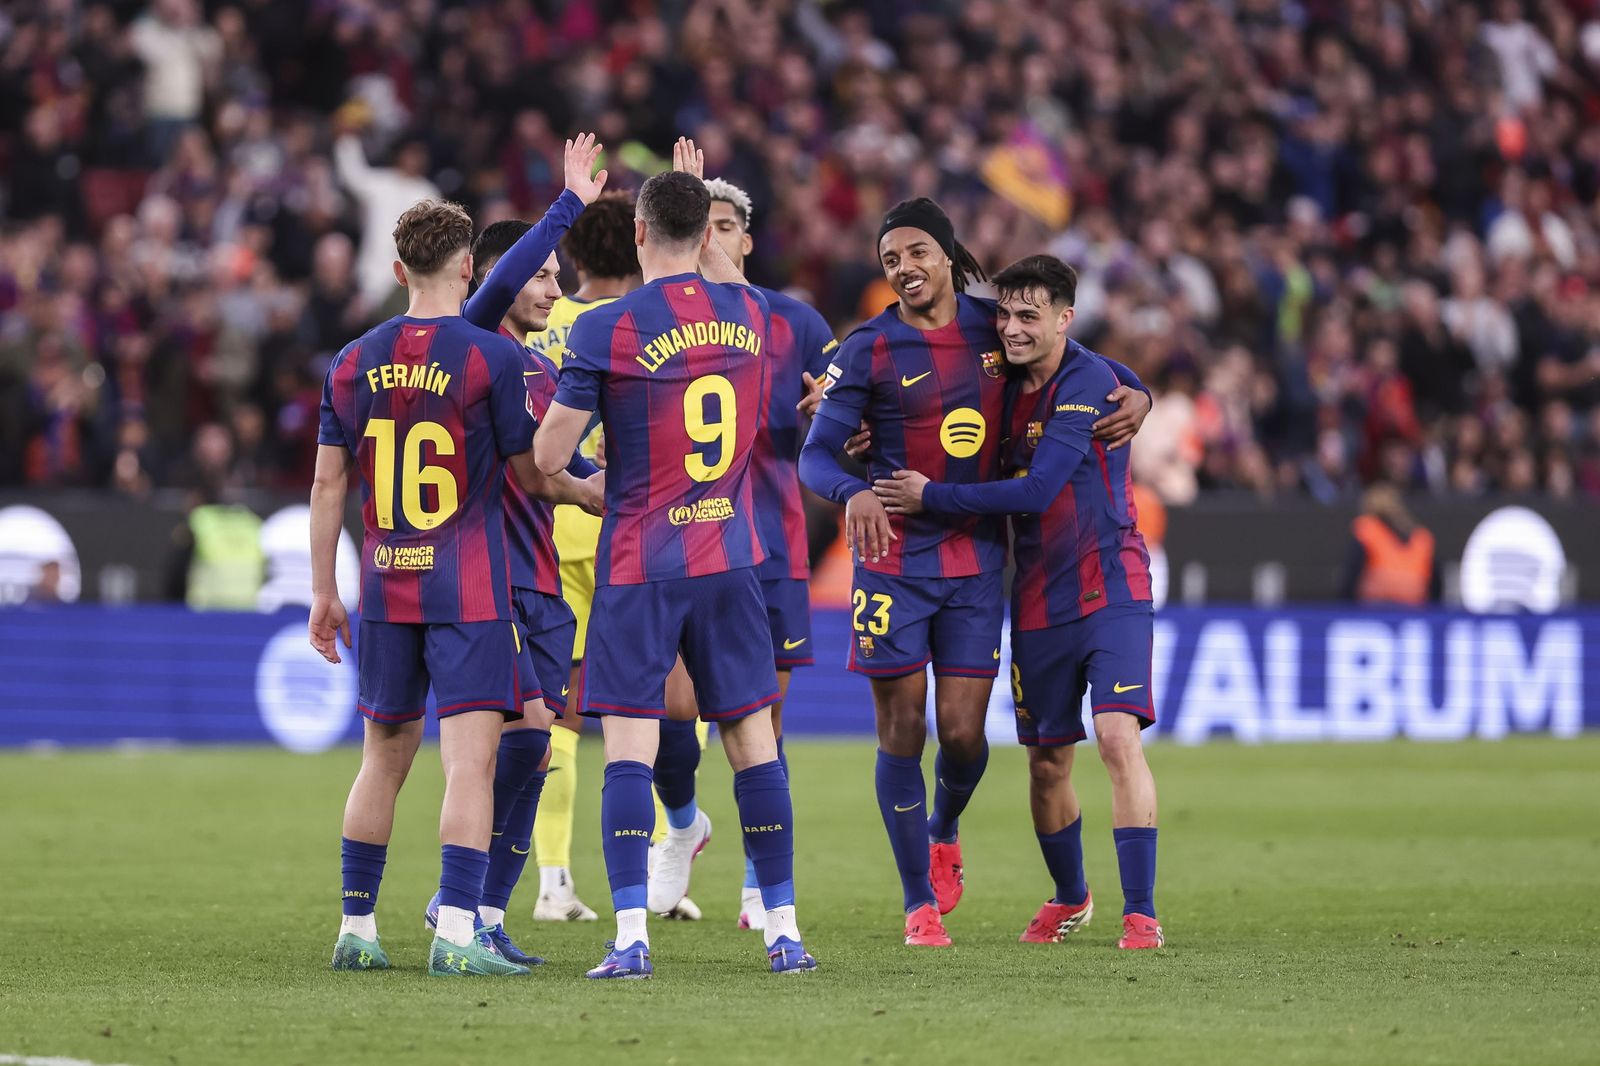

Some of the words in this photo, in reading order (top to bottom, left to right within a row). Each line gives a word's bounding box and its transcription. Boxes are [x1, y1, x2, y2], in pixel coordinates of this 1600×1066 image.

[635, 320, 762, 373] LEWANDOWSKI
[366, 362, 451, 397] FERMÍN
[683, 374, 737, 482] 9
[1055, 404, 1095, 414] AMBILIGHT
[364, 418, 459, 531] 16
[393, 555, 434, 566] ACNUR
[394, 545, 434, 556] UNHCR
[853, 588, 893, 635] 23
[1173, 618, 1584, 745] ALBUM
